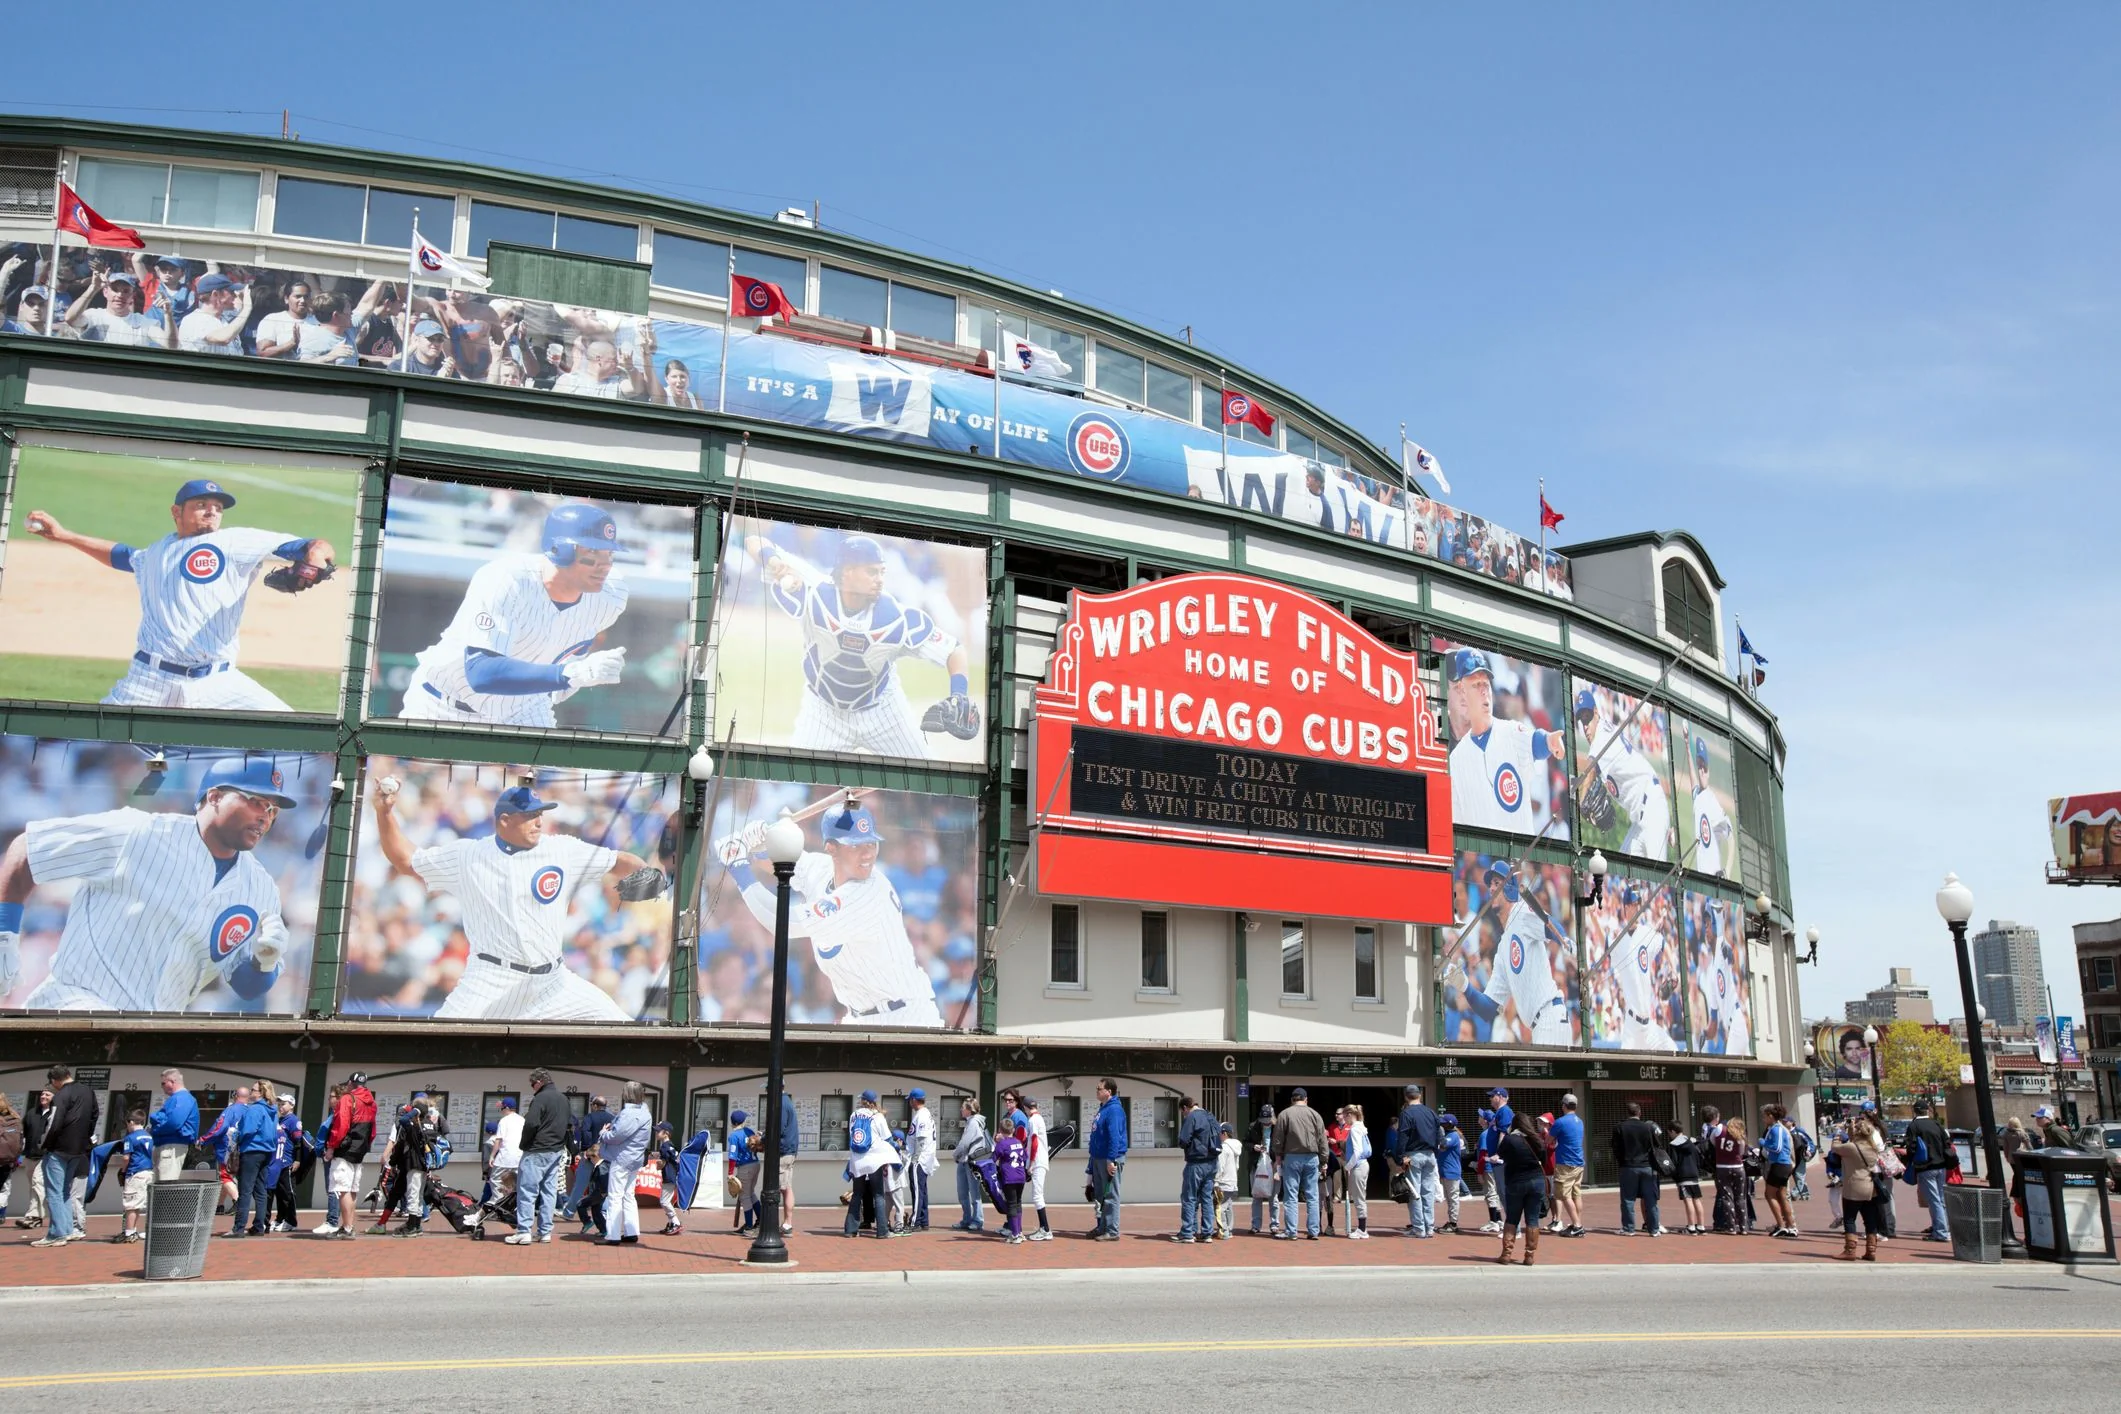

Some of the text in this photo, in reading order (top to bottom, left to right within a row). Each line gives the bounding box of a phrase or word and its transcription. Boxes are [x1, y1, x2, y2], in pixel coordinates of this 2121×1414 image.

[747, 376, 796, 397] IT'S
[802, 385, 819, 401] A
[967, 414, 994, 431] OF
[1002, 420, 1049, 442] LIFE
[479, 614, 493, 627] 10
[1089, 594, 1406, 705] WRIGLEY FIELD
[1185, 649, 1327, 694] HOME OF
[1088, 681, 1409, 764] CHICAGO CUBS
[1216, 753, 1300, 785] TODAY
[1082, 762, 1417, 821] TEST DRIVE A CHEVY AT WRIGLEY
[1121, 792, 1385, 839] & WIN FREE CUBS TICKETS!
[1223, 1055, 1236, 1072] G
[1446, 1058, 1457, 1066] BAG
[1436, 1067, 1466, 1075] INSPECTION
[1640, 1065, 1667, 1079] GATE F
[125, 1083, 138, 1092] 25
[204, 1083, 216, 1091] 24
[425, 1084, 438, 1092] 22
[2008, 1076, 2046, 1087] Parking
[1720, 1137, 1734, 1152] 13
